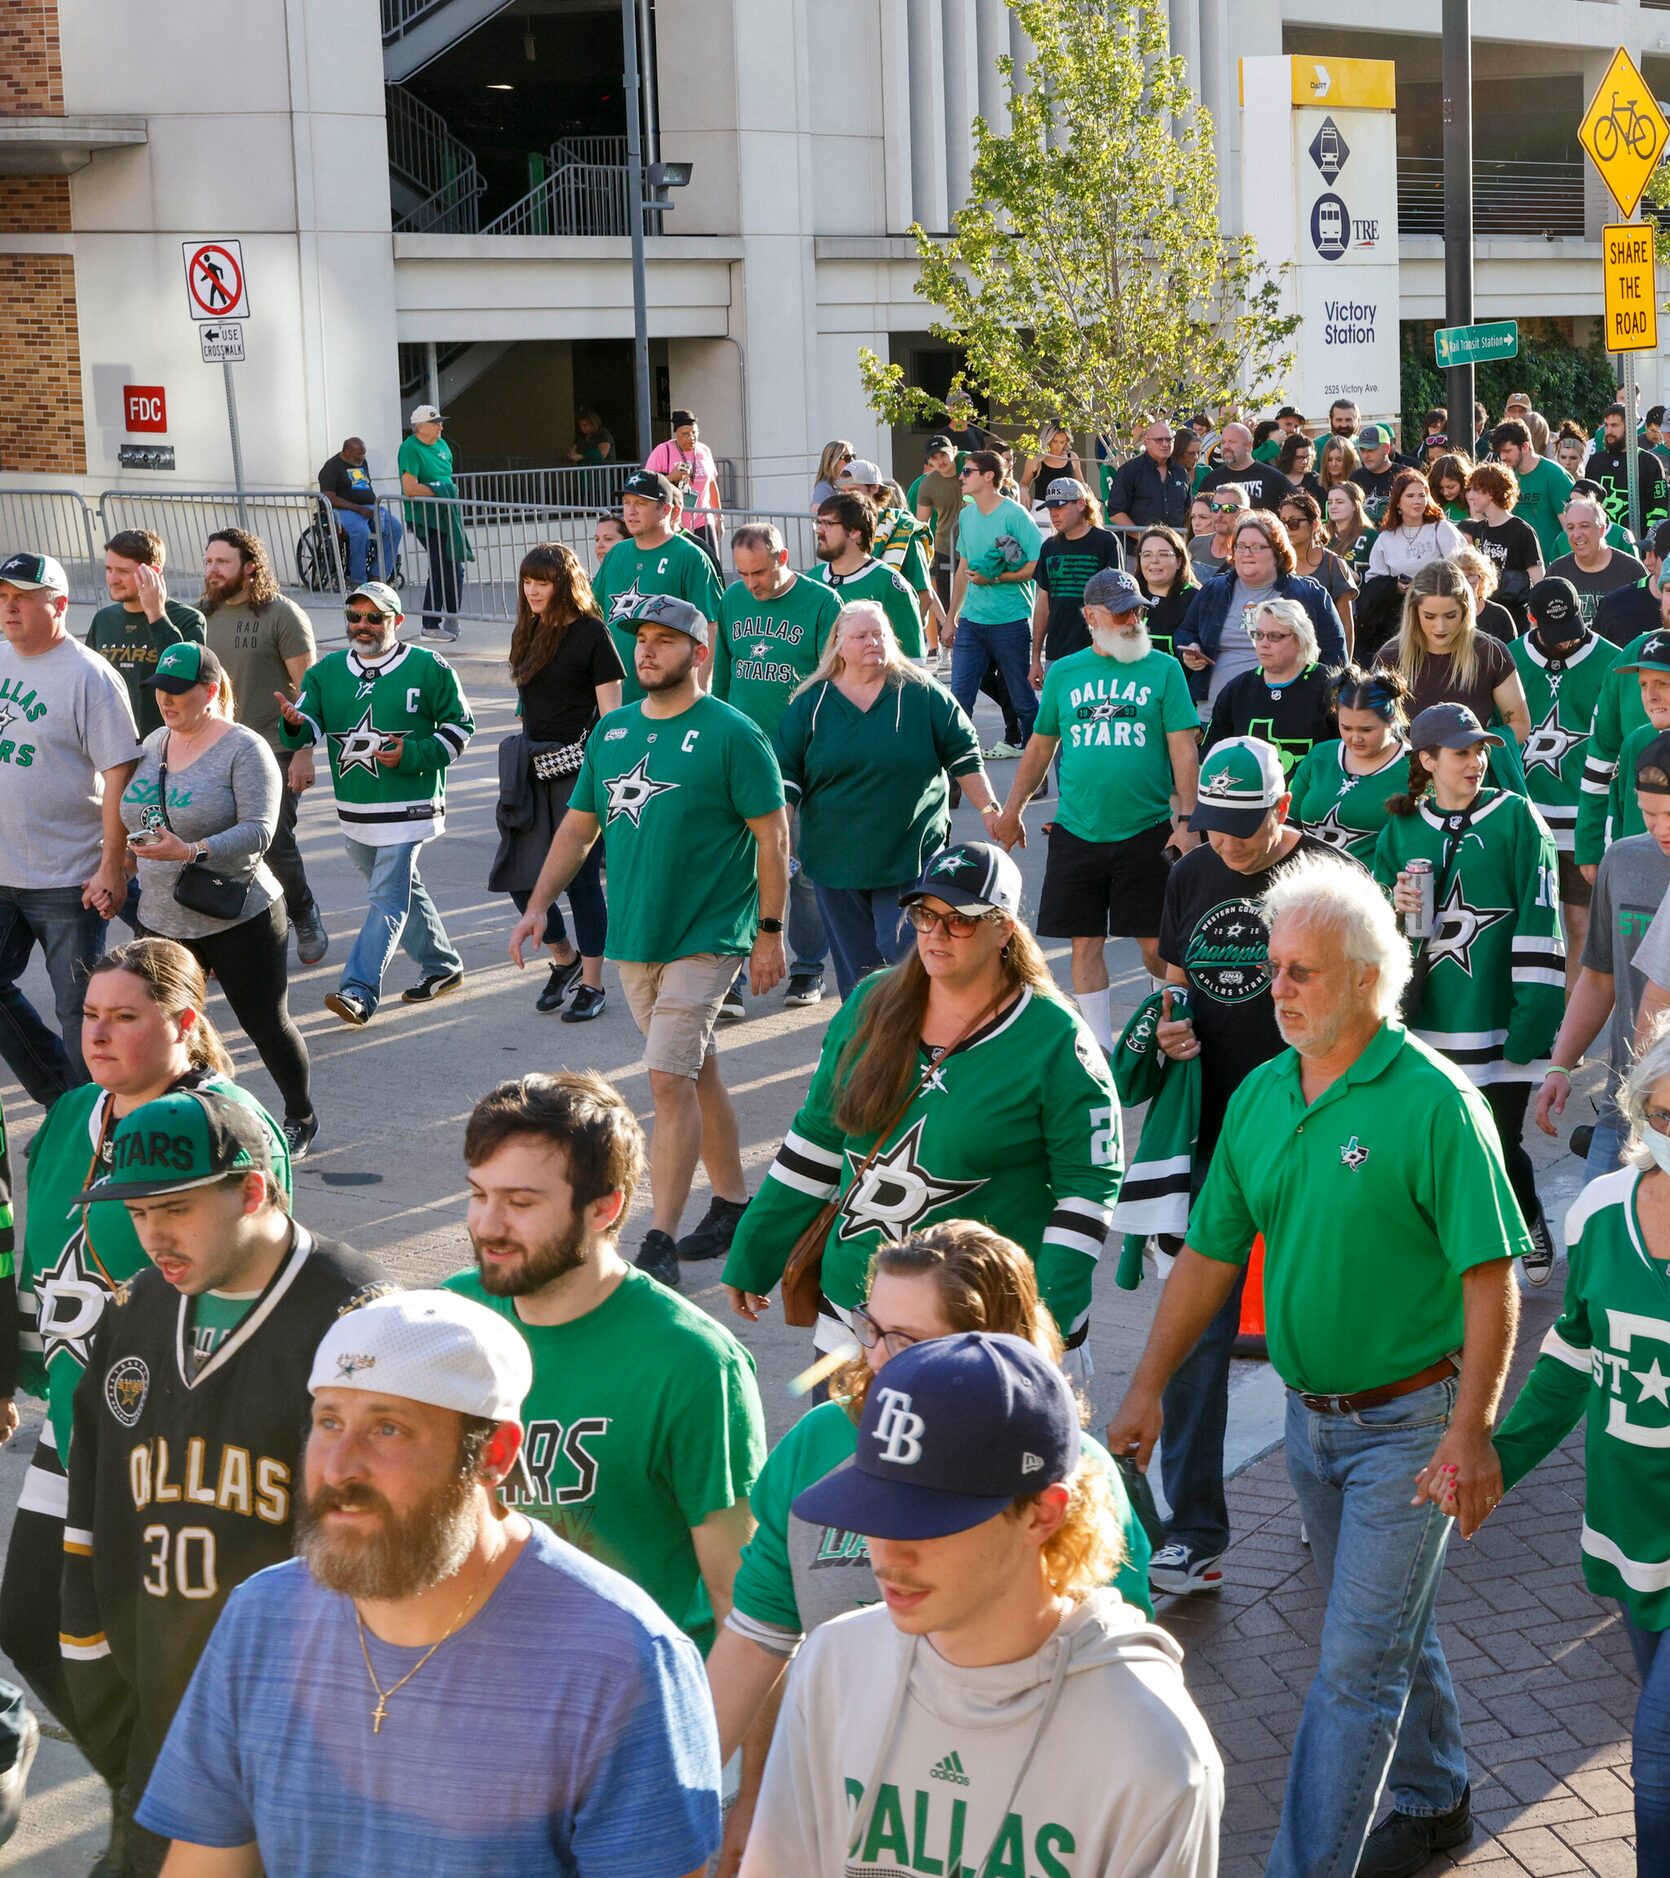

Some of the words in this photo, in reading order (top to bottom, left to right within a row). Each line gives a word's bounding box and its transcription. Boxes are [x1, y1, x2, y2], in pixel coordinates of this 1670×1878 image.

[1310, 81, 1327, 90] DART
[1352, 219, 1380, 241] TRE
[1610, 240, 1648, 265] SHARE
[1619, 276, 1641, 300] THE
[1324, 301, 1377, 325] Victory
[1616, 311, 1647, 335] ROAD
[221, 329, 239, 341] USE
[1324, 324, 1375, 345] Station
[1449, 341, 1460, 353] Rail
[1460, 338, 1480, 351] Transit
[1481, 334, 1504, 348] Station
[203, 344, 242, 357] CROSSWALK
[1324, 384, 1340, 395] 2525
[1341, 384, 1363, 396] Victory
[1365, 383, 1379, 393] Ave.
[130, 397, 161, 422] FDC
[1046, 487, 1061, 496] ARS
[657, 557, 668, 574] C
[236, 620, 259, 633] RAD
[732, 616, 804, 645] DALLAS
[234, 636, 258, 649] DAD
[735, 660, 792, 682] STARS
[1, 677, 48, 723] LLAS
[406, 687, 421, 713] C
[1070, 678, 1152, 709] DALLAS
[1079, 709, 1088, 718] 19
[1124, 707, 1135, 716] 93
[681, 729, 700, 753] C
[1069, 721, 1147, 748] STARS
[122, 778, 193, 808] Strs
[1201, 905, 1236, 931] WESTERN
[1617, 913, 1655, 937] ST
[1185, 933, 1269, 962] Champio
[1198, 972, 1233, 996] DALLAS
[871, 1387, 926, 1465] TB
[130, 1436, 291, 1526] DLLAS
[817, 1527, 870, 1560] DA
[143, 1524, 218, 1599] 30
[929, 1767, 970, 1787] adidas
